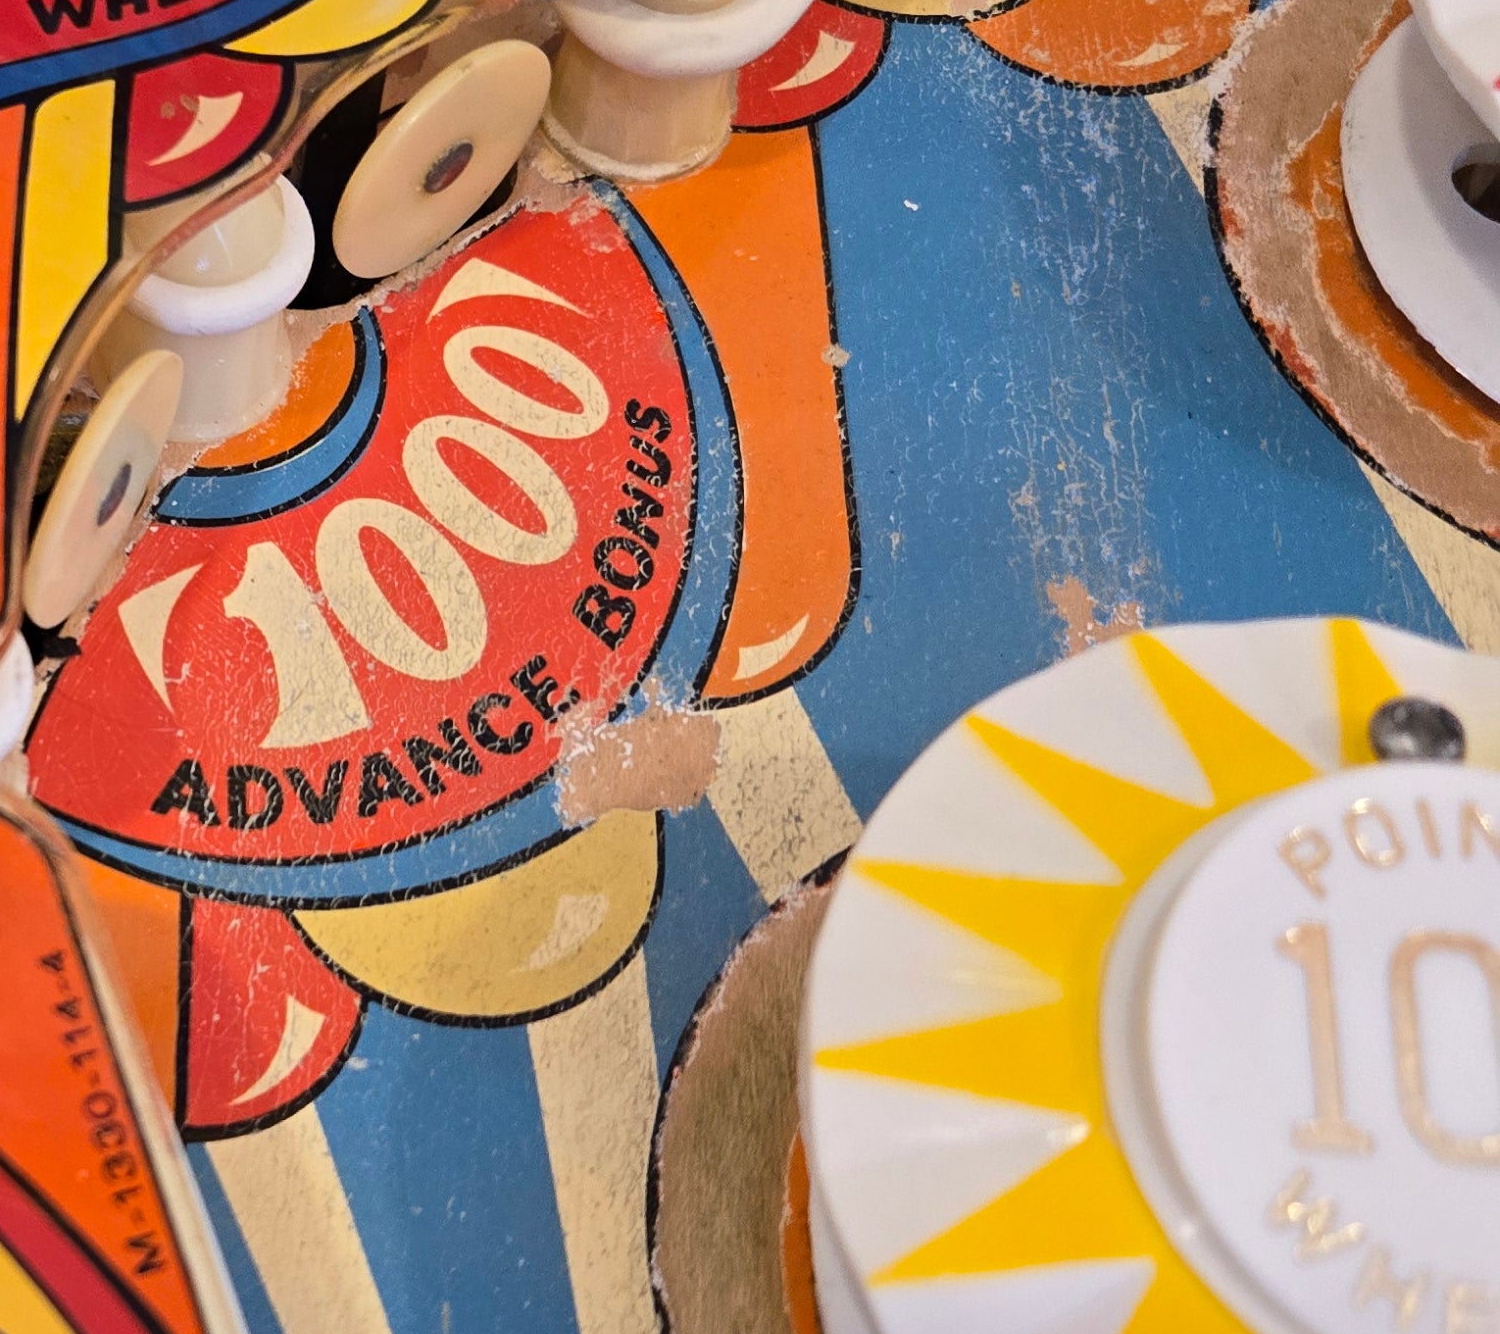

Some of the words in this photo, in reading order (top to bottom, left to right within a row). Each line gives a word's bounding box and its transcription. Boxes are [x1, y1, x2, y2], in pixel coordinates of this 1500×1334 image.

[150, 654, 581, 832] ADVANCE
[572, 397, 674, 652] BONUS
[222, 324, 610, 750] 1000
